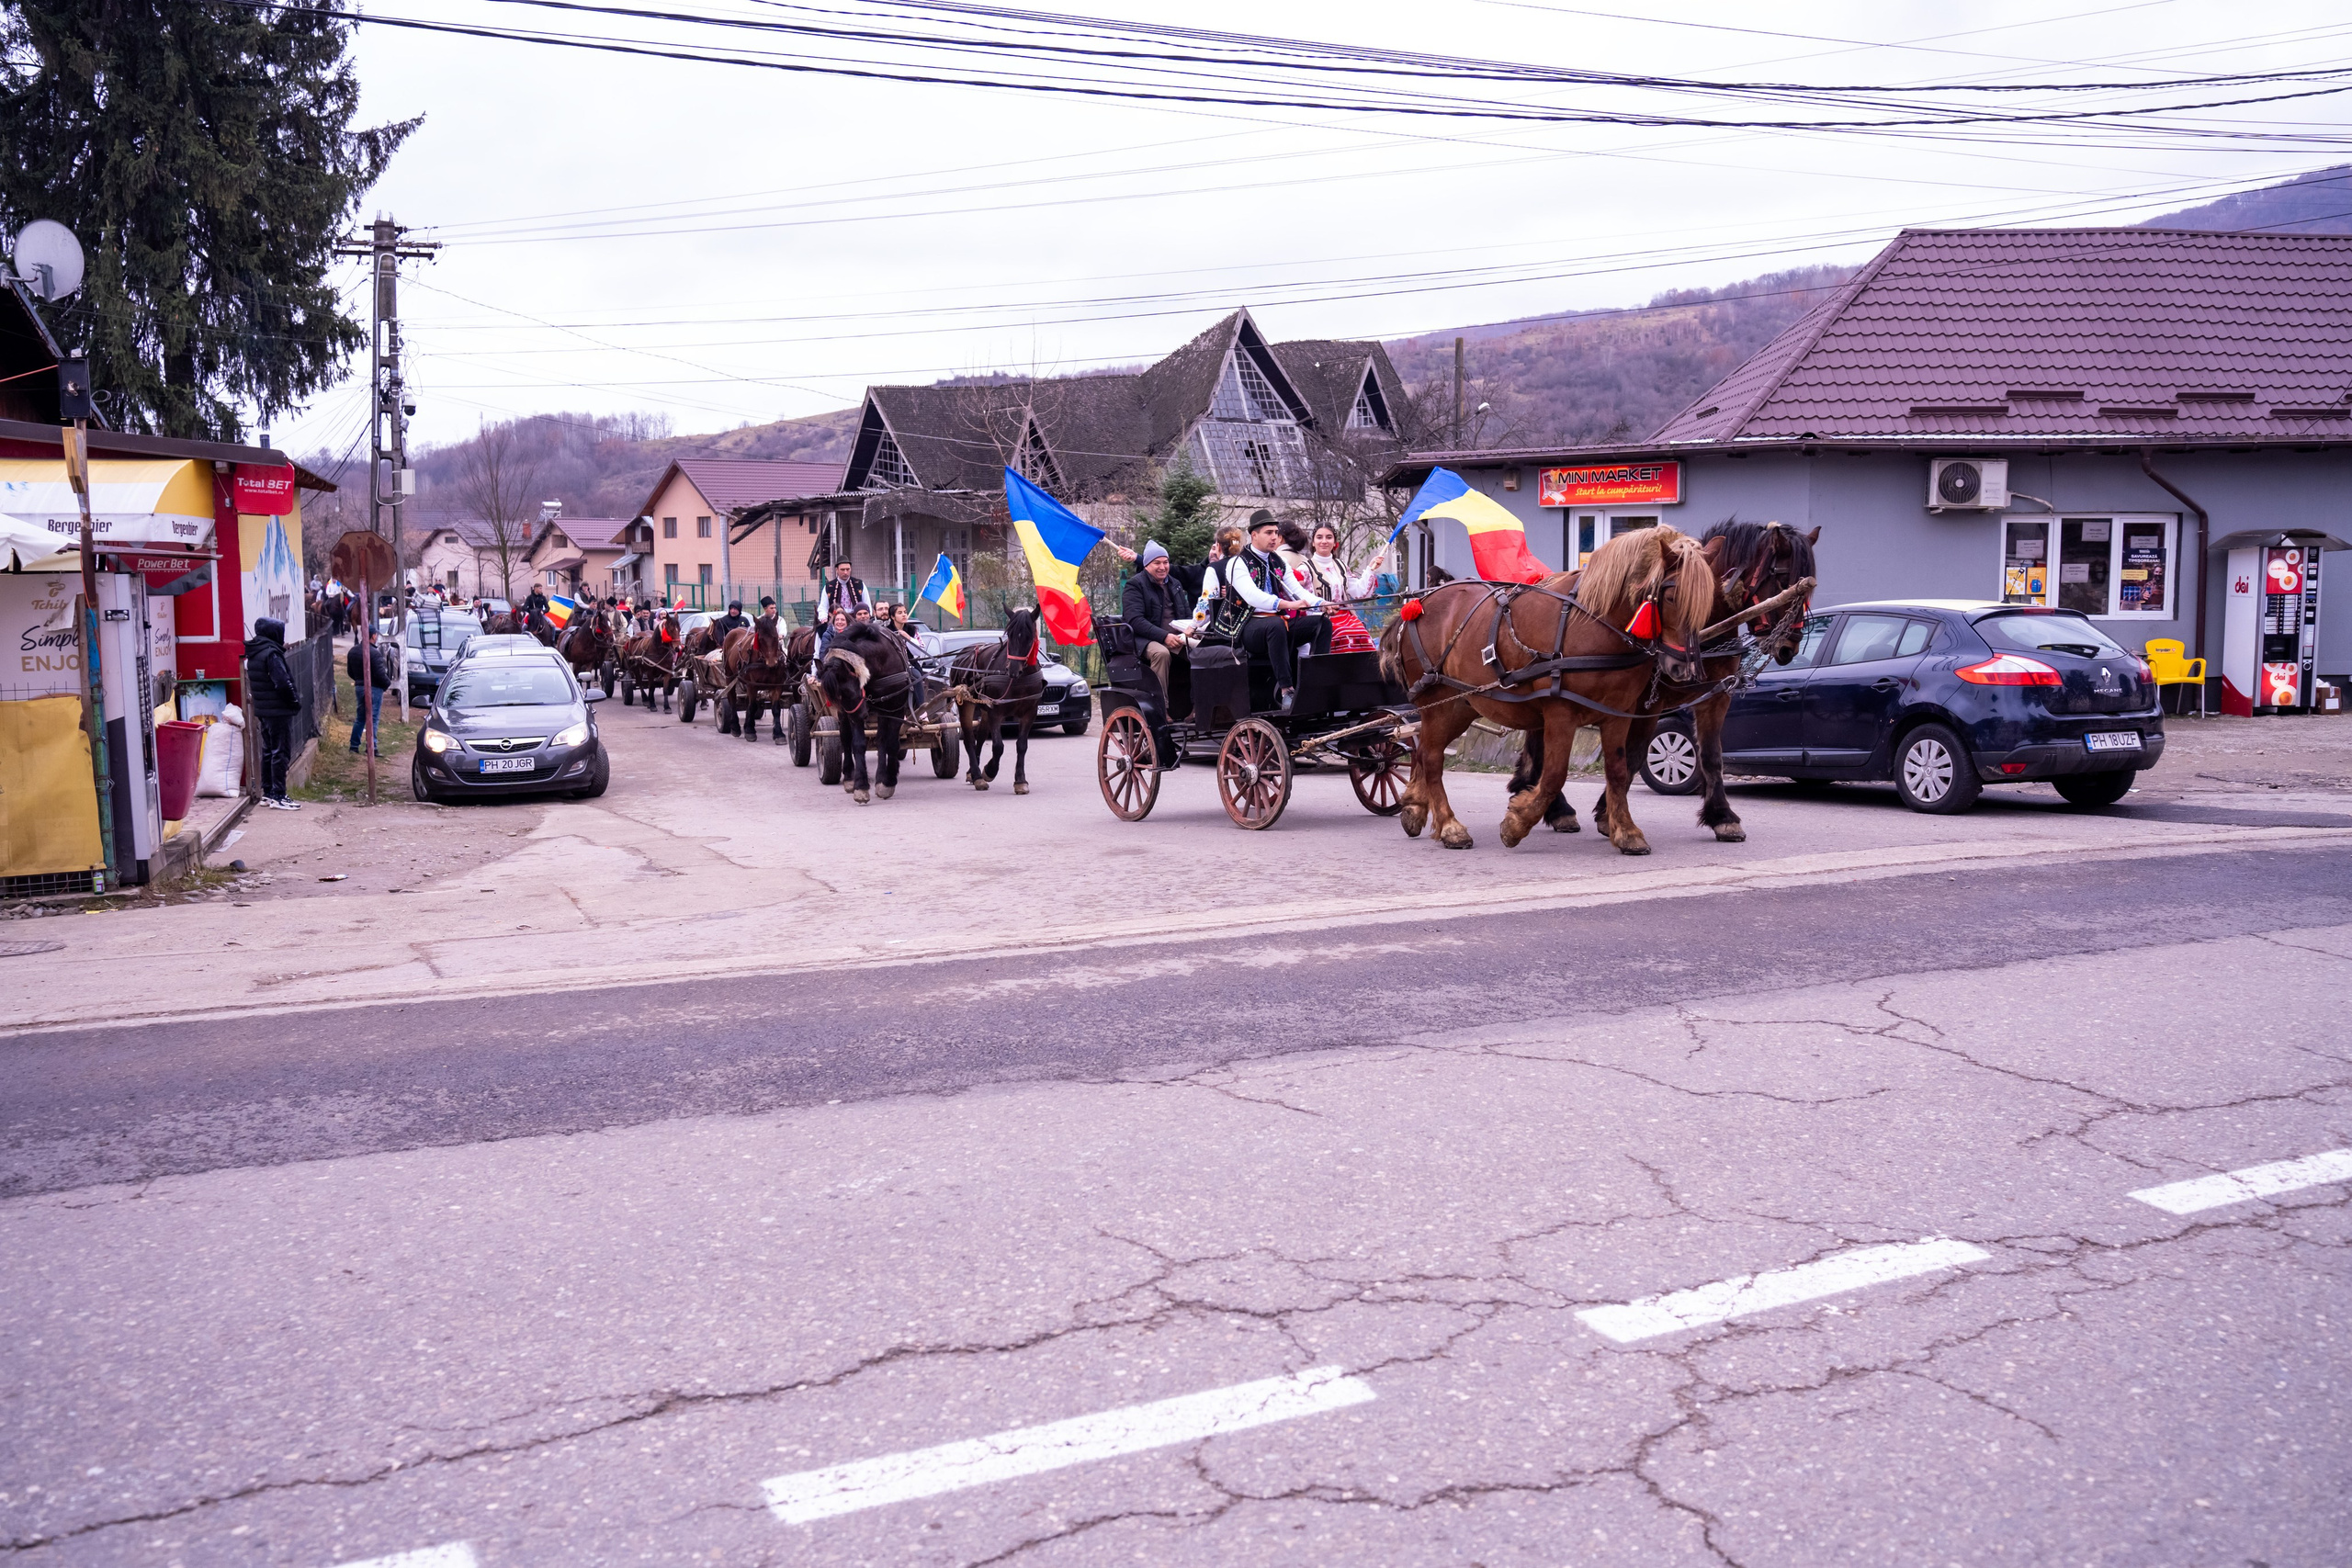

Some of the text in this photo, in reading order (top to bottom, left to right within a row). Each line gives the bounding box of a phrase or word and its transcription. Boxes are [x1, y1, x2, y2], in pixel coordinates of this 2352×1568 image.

[237, 477, 292, 490] Total BET
[1557, 467, 1663, 485] MINI MARKET
[1575, 483, 1663, 498] Start la cumpărături!
[48, 519, 112, 535] Bergebier
[172, 520, 198, 537] Bergenbier
[2234, 576, 2249, 593] dai
[31, 599, 69, 610] Tchib
[20, 625, 79, 652] Simpl
[155, 646, 172, 657] ENJOY
[21, 654, 80, 672] ENJO
[2091, 735, 2108, 748] PH
[484, 759, 532, 770] PH 20 JGR
